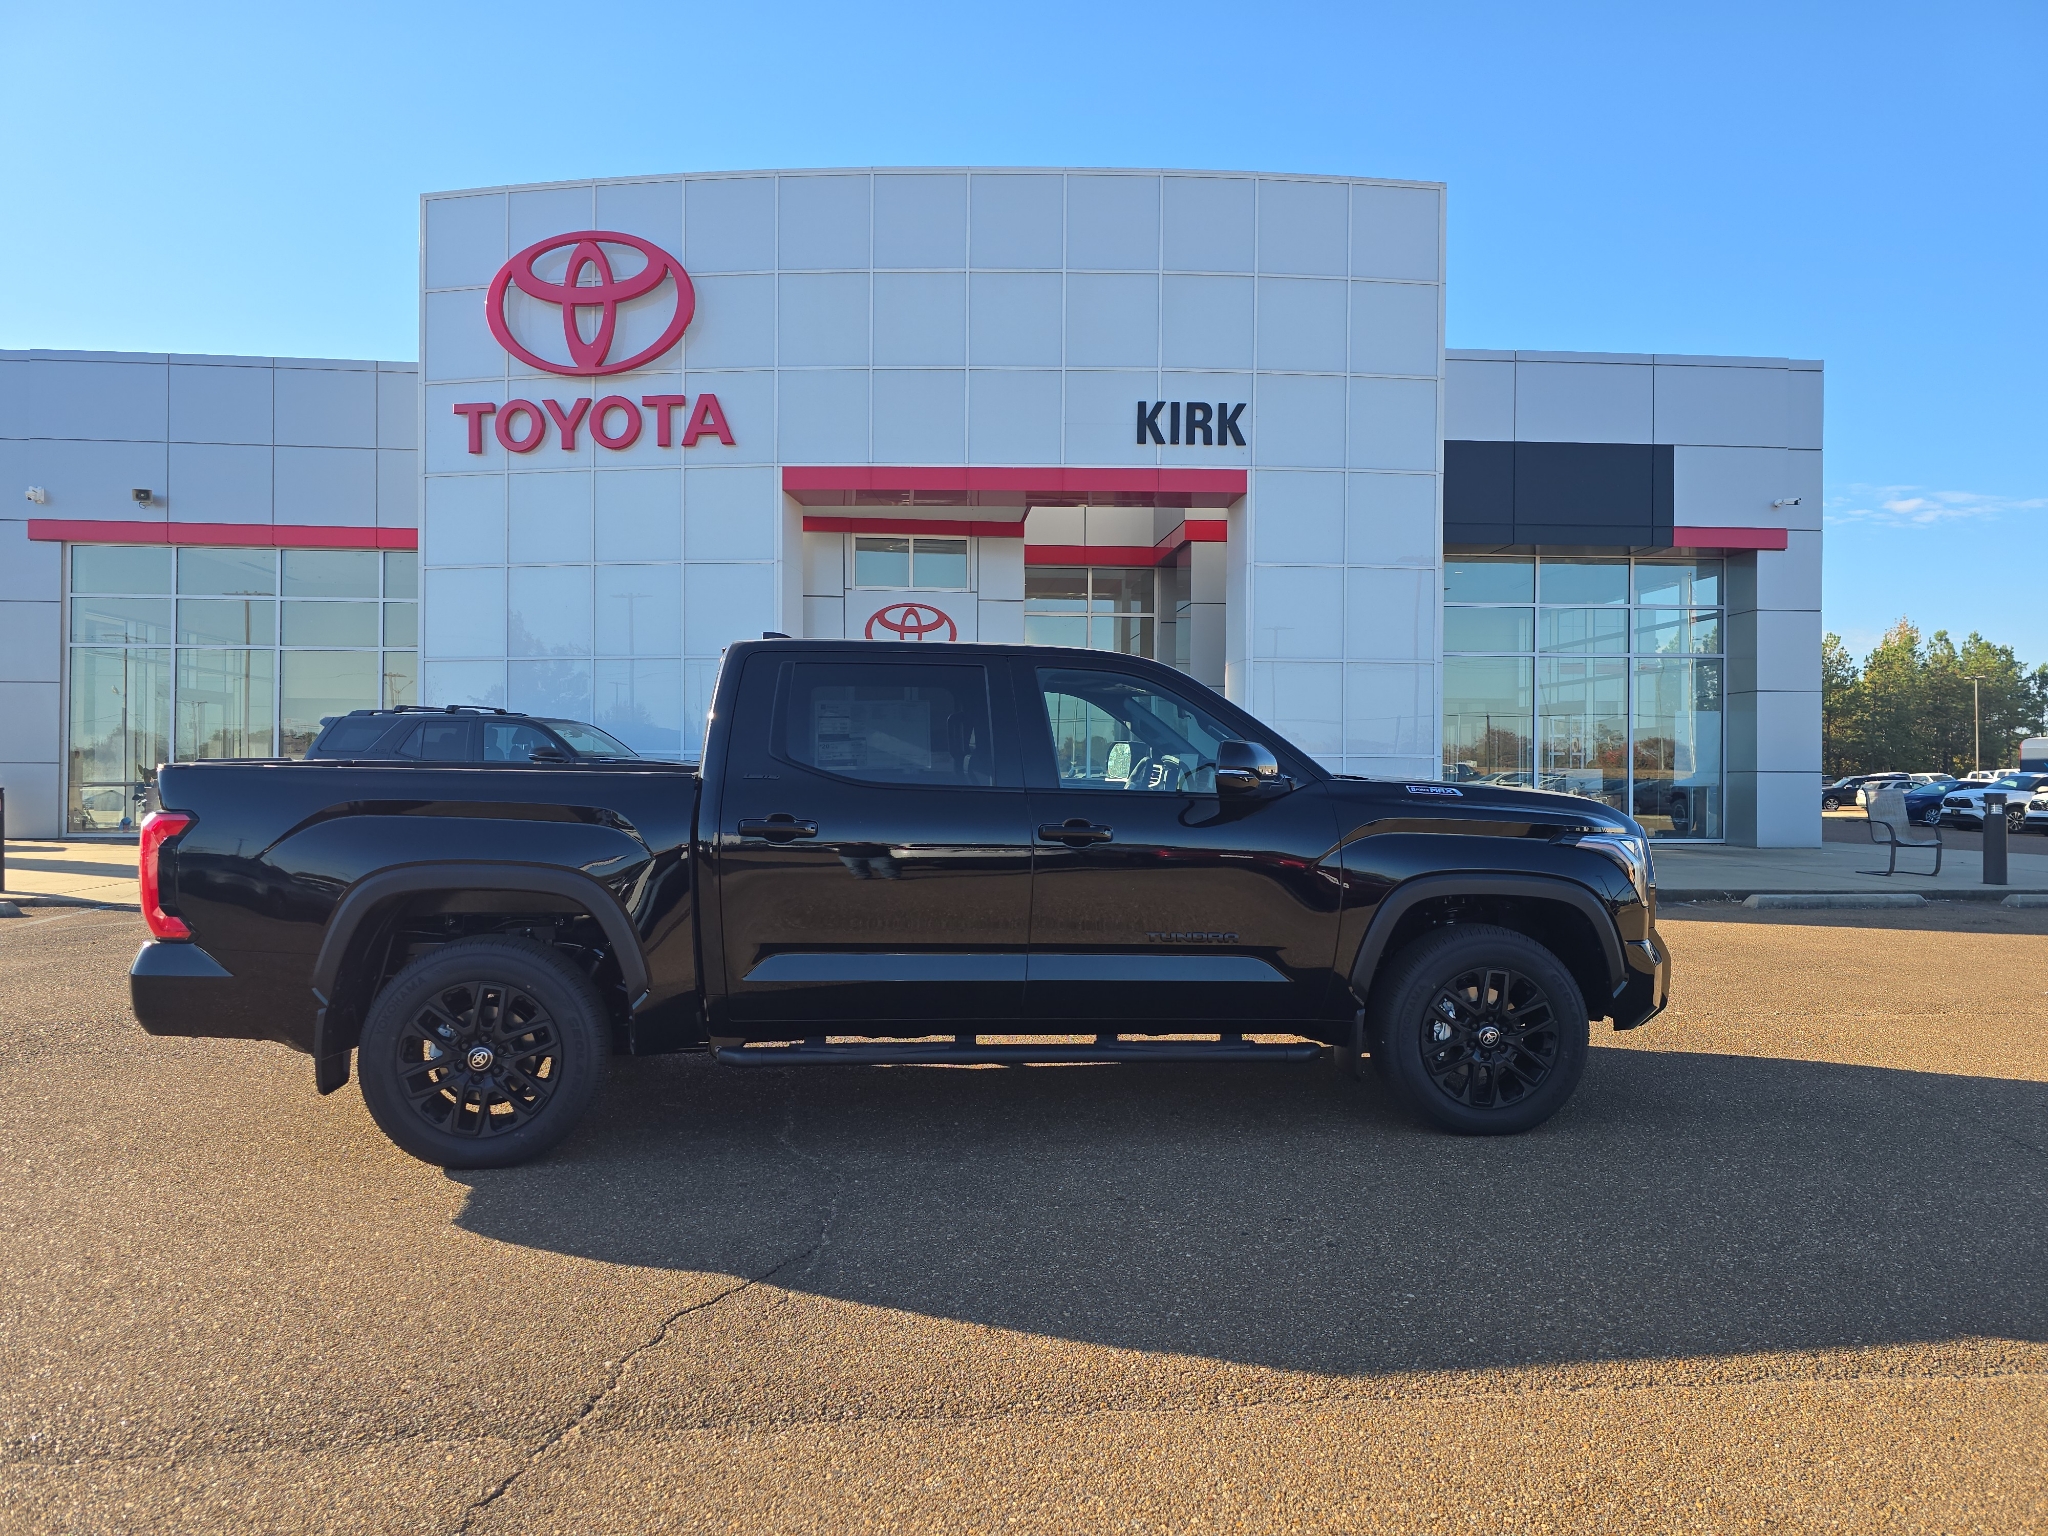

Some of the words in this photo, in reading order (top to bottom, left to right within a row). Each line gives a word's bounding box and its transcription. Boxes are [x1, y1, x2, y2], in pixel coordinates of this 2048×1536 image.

[453, 394, 736, 454] TOYOTA
[1137, 401, 1247, 446] KIRK
[1145, 931, 1239, 943] TUNDRA
[374, 976, 427, 1035] YOKOHAMA
